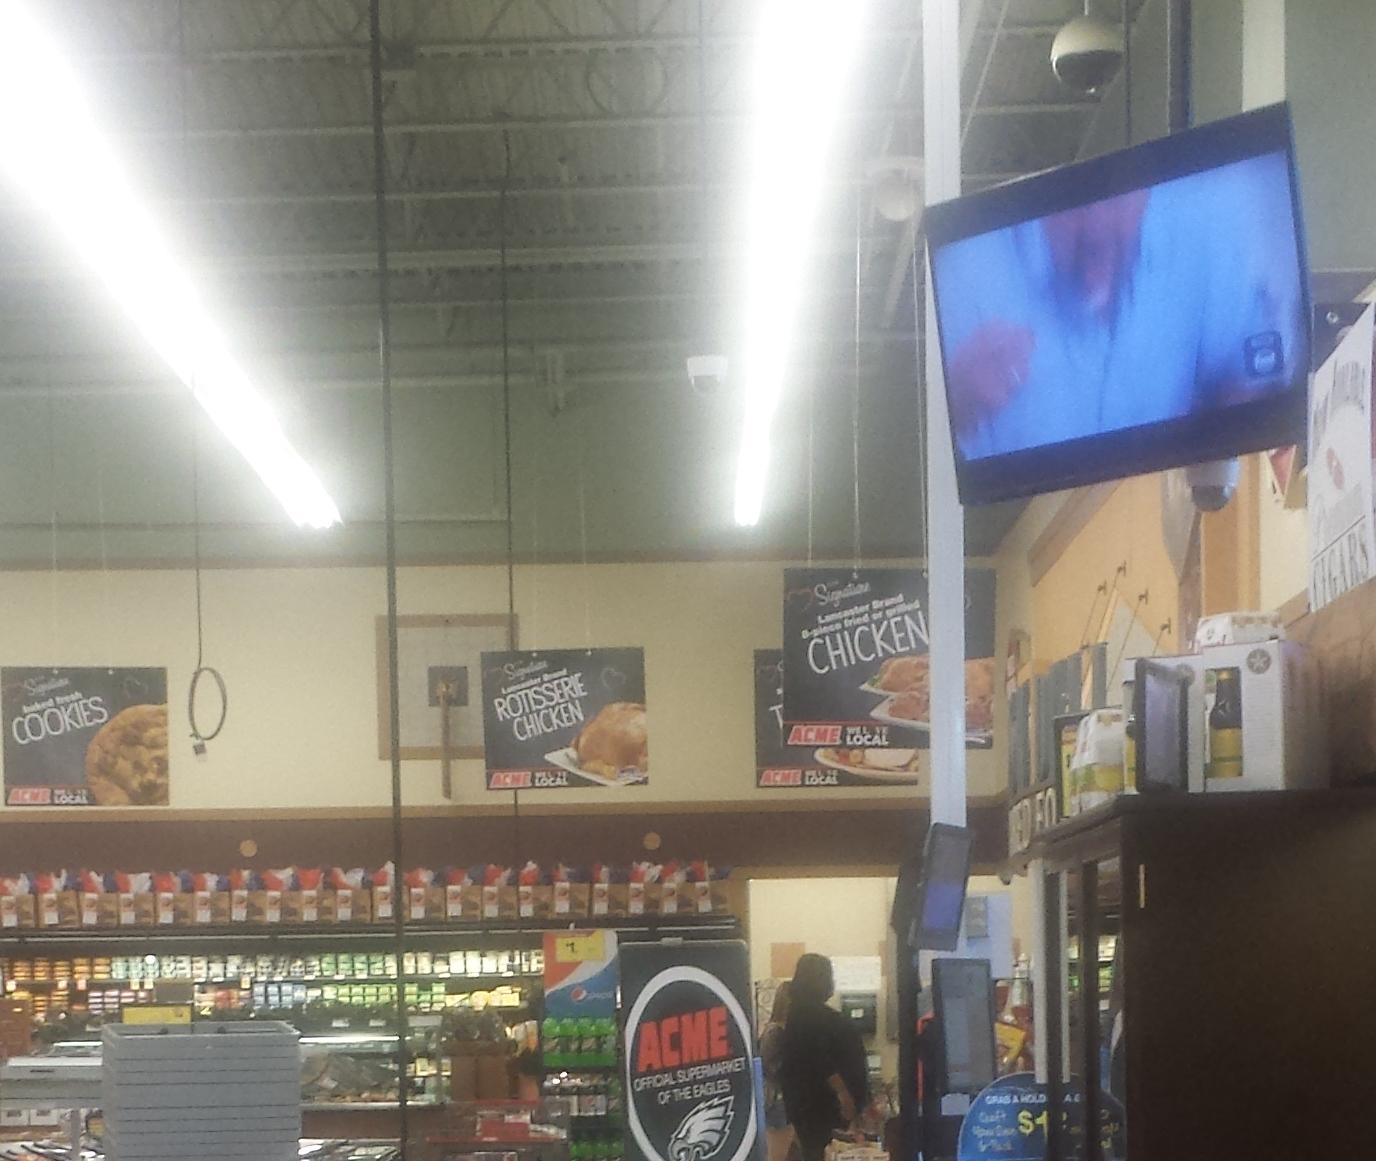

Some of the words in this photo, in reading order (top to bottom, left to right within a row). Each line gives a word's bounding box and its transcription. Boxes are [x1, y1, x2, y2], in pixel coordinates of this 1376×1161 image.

[808, 610, 929, 675] CHICKEN
[494, 672, 588, 722] ROTISSERIE
[12, 697, 109, 744] COOKIES
[513, 700, 585, 741] CHICKEN
[790, 726, 841, 744] ACME
[846, 735, 889, 746] LOCAL
[762, 770, 801, 785] ACME
[636, 1006, 731, 1073] ACME
[633, 1073, 676, 1092] OFFICIAL
[677, 1056, 746, 1084] SUPERMARKET
[657, 1090, 672, 1105] OF
[673, 1086, 693, 1102] THE
[692, 1078, 731, 1099] EAGLES
